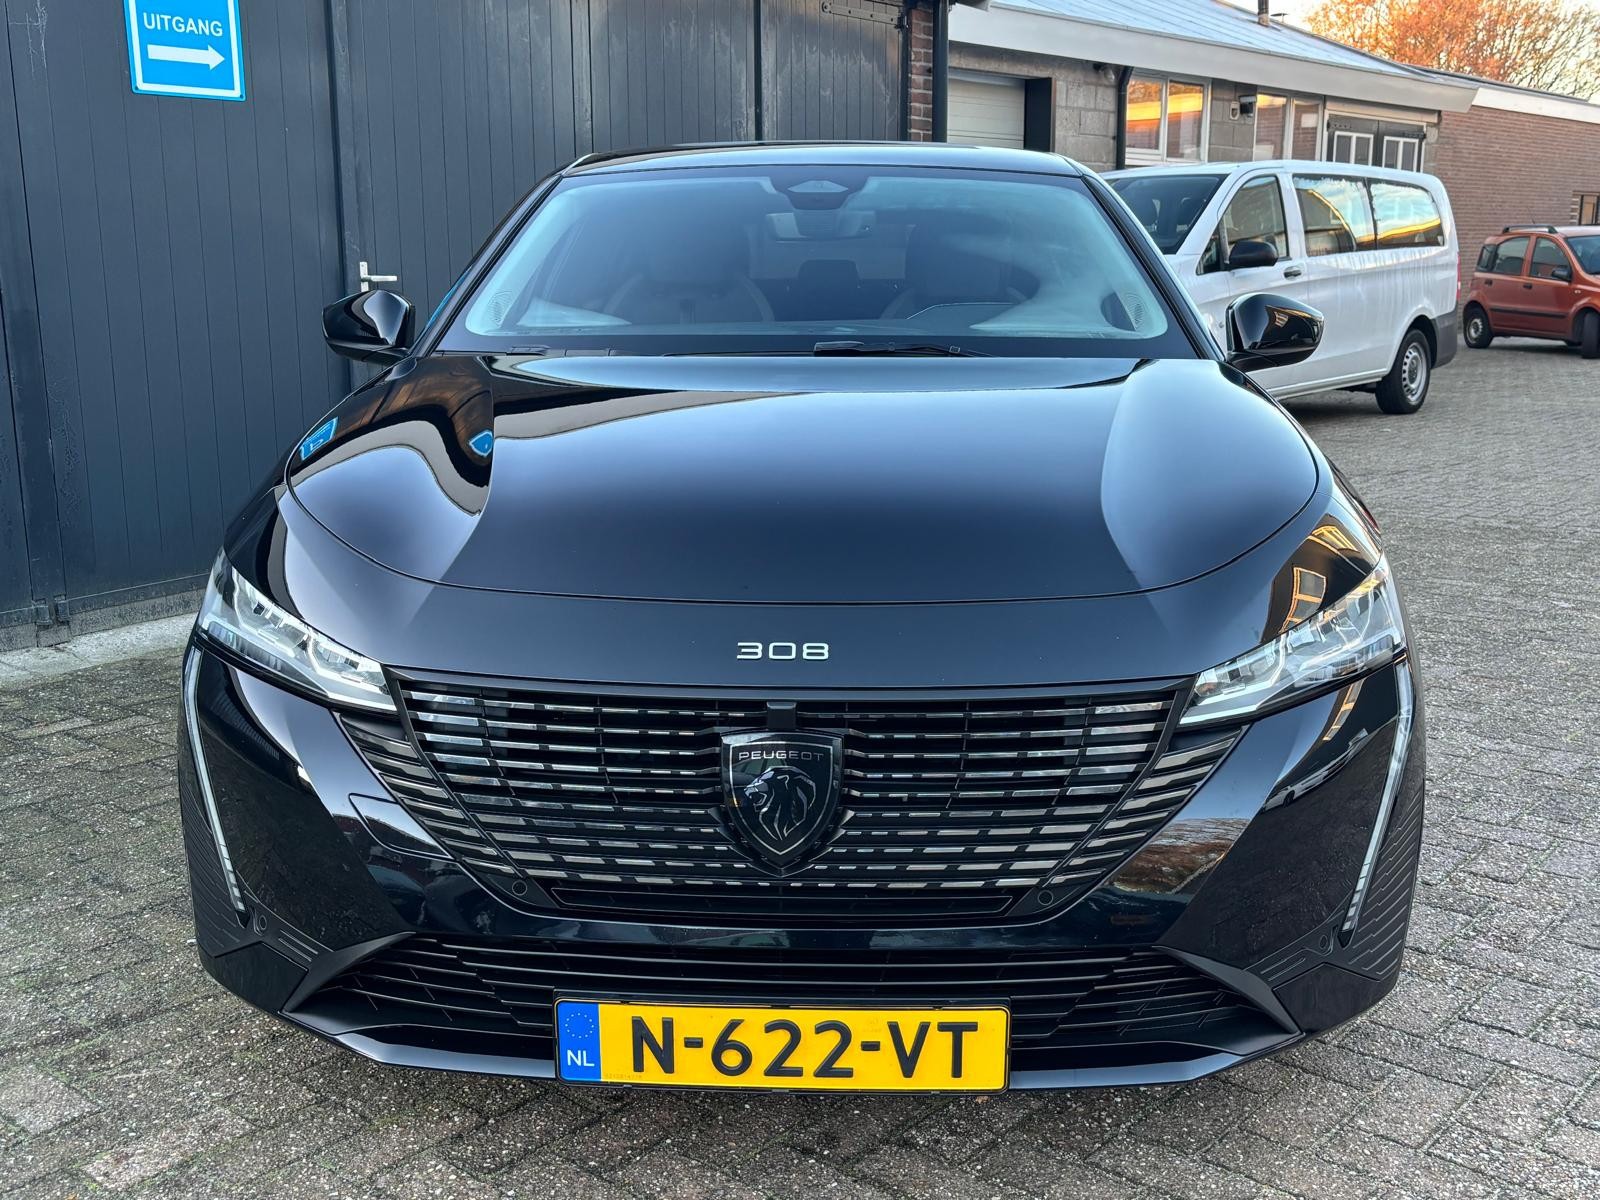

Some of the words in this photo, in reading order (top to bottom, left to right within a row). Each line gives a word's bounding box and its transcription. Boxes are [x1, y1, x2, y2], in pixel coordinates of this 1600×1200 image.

[143, 12, 223, 37] UITGANG
[737, 642, 829, 660] 308
[738, 750, 824, 761] PEUGEOT
[631, 1015, 979, 1079] N-622-VT
[567, 1049, 595, 1067] NL
